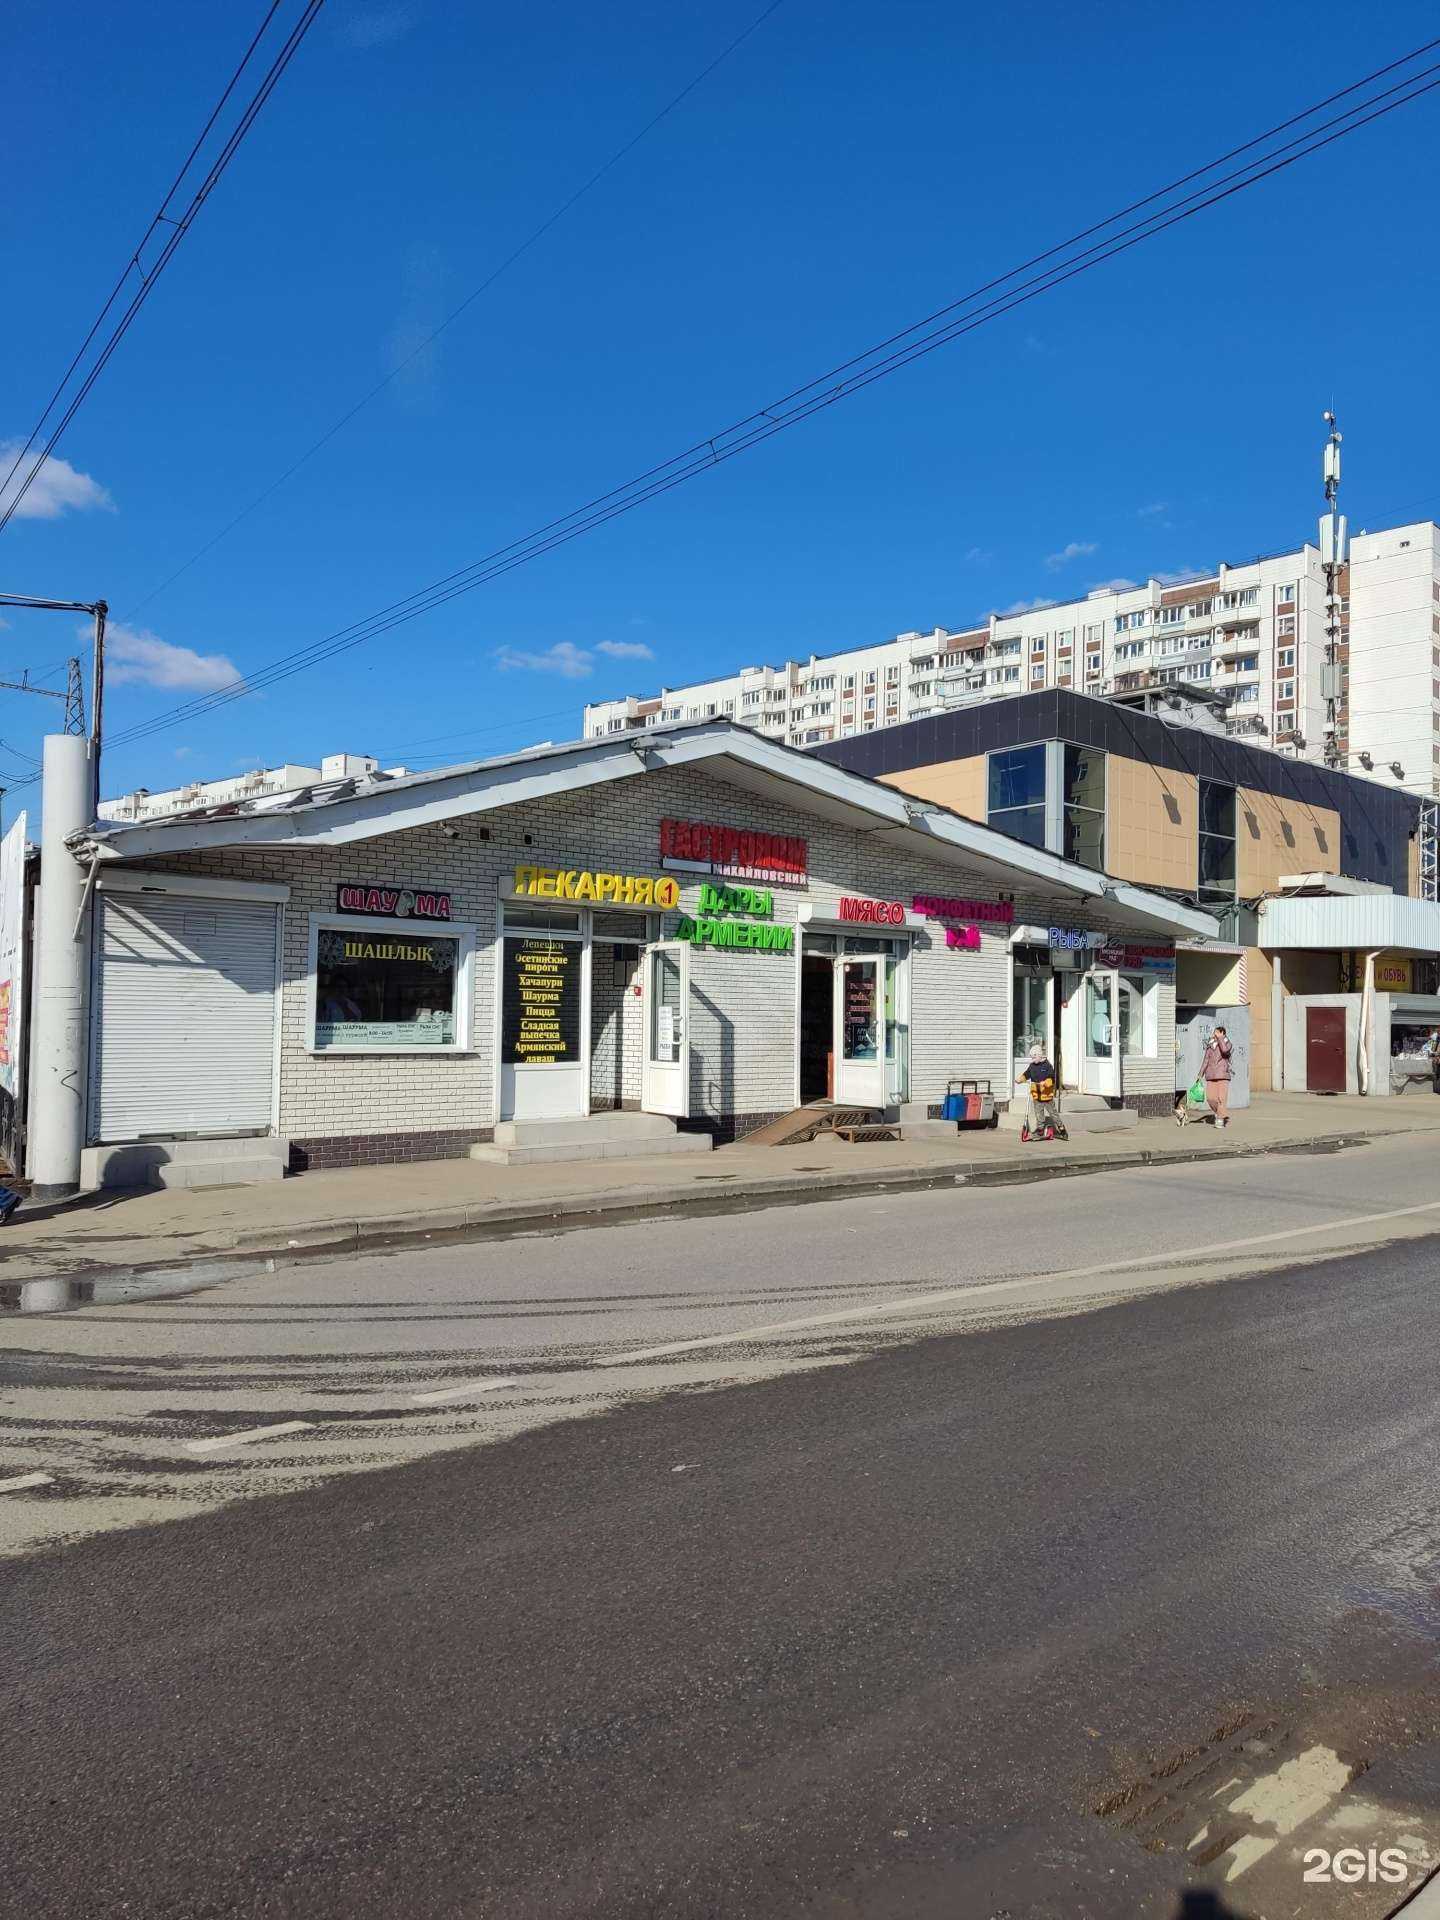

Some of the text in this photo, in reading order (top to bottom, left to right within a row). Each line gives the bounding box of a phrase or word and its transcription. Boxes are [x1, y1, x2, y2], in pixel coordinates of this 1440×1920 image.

[660, 817, 808, 874] ГАСТРОНОМ
[516, 866, 653, 905] ПЕКАРНЯ
[340, 887, 451, 917] ШАУРМА
[698, 883, 773, 915] ДАРЫ
[839, 896, 904, 925] МЯСО
[674, 917, 794, 950] АРМЕНИИ
[1049, 927, 1090, 949] РЫБА
[344, 942, 434, 961] ШАШЛЫК
[515, 953, 568, 964] Осетинские
[525, 963, 558, 972] пироги
[519, 976, 563, 987] Хачапури
[522, 991, 560, 1002] Шаурма
[526, 1006, 555, 1016] Пицца
[521, 1021, 559, 1031] Сладкая
[520, 1031, 560, 1040] выпечка
[515, 1042, 566, 1053] Армянский
[525, 1055, 555, 1063] лаваш
